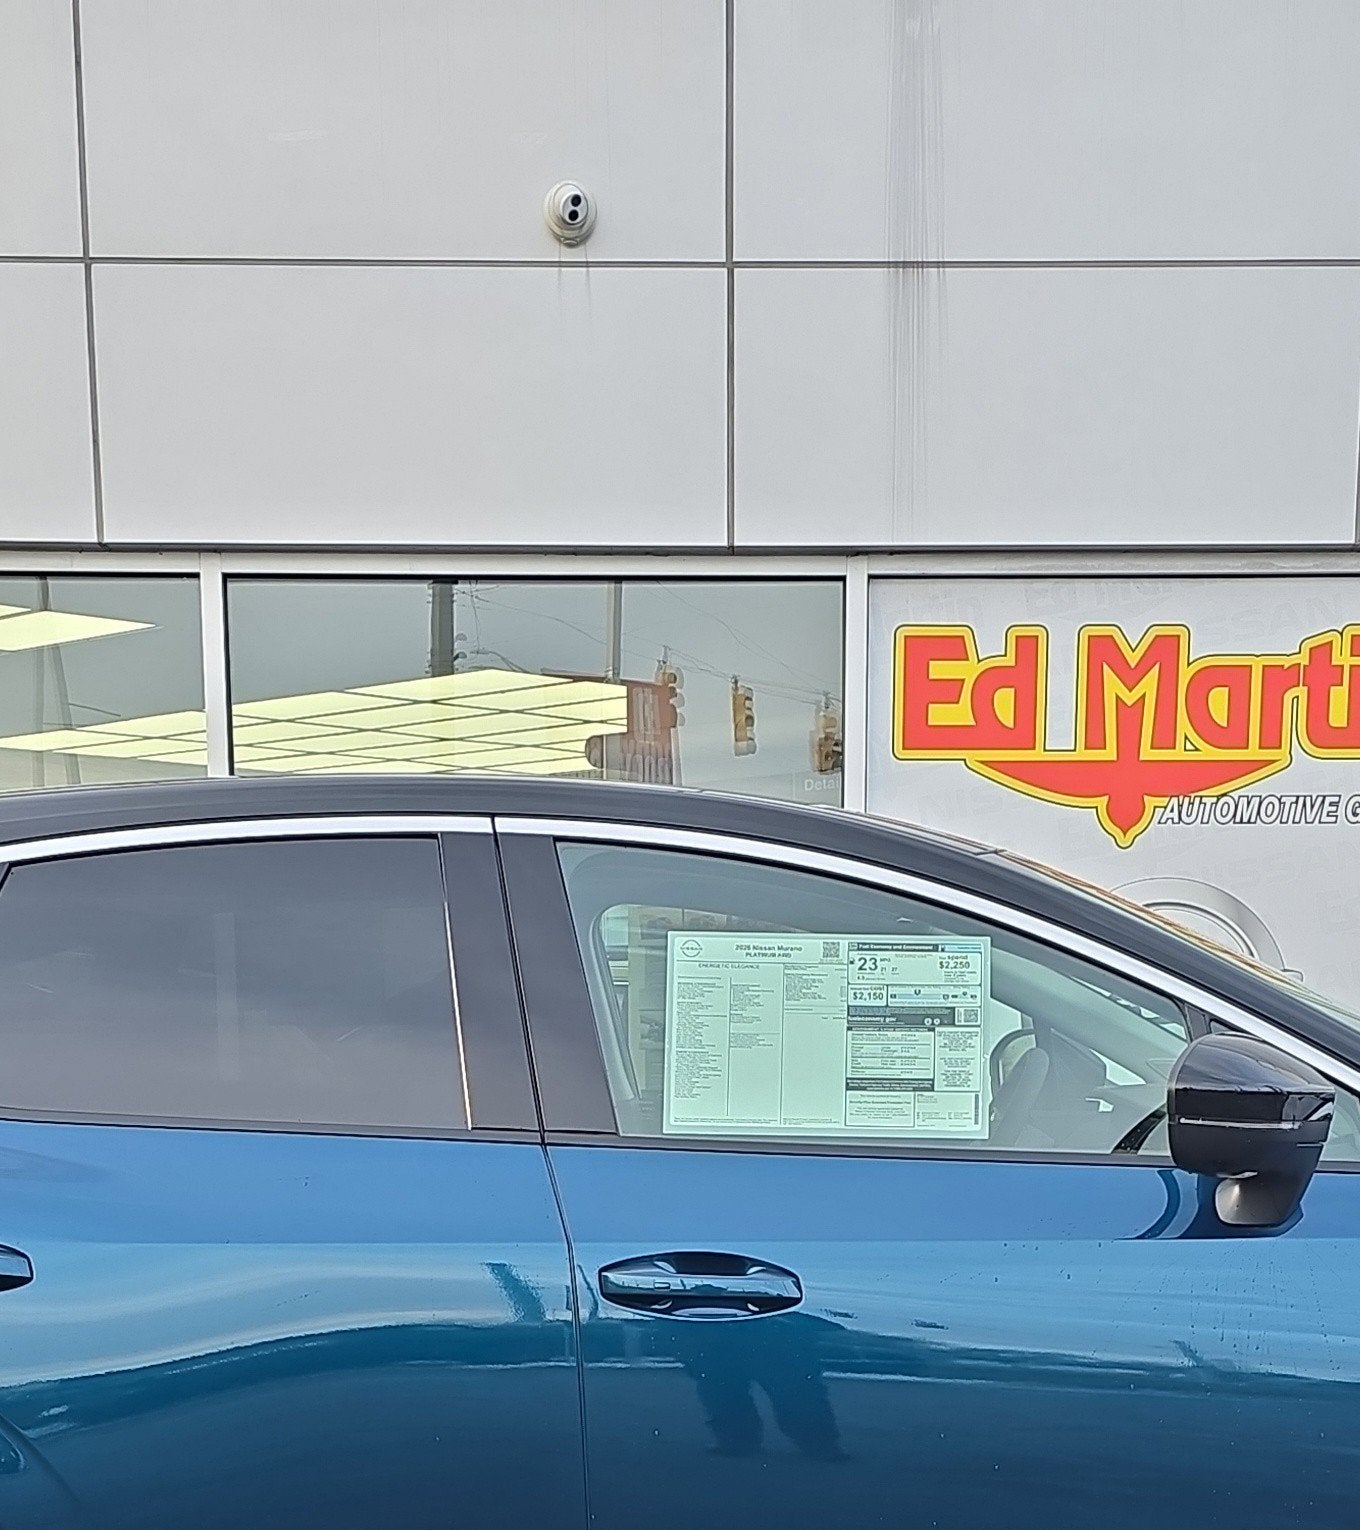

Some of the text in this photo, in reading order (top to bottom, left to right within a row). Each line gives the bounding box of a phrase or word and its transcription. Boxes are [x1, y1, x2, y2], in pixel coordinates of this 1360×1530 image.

[896, 628, 1044, 756] Ed
[1158, 795, 1341, 824] AUTOMOTIVE
[777, 944, 803, 952] Murano
[857, 957, 878, 971] 23
[939, 961, 971, 970] $2,250
[852, 991, 884, 1001] $2,150
